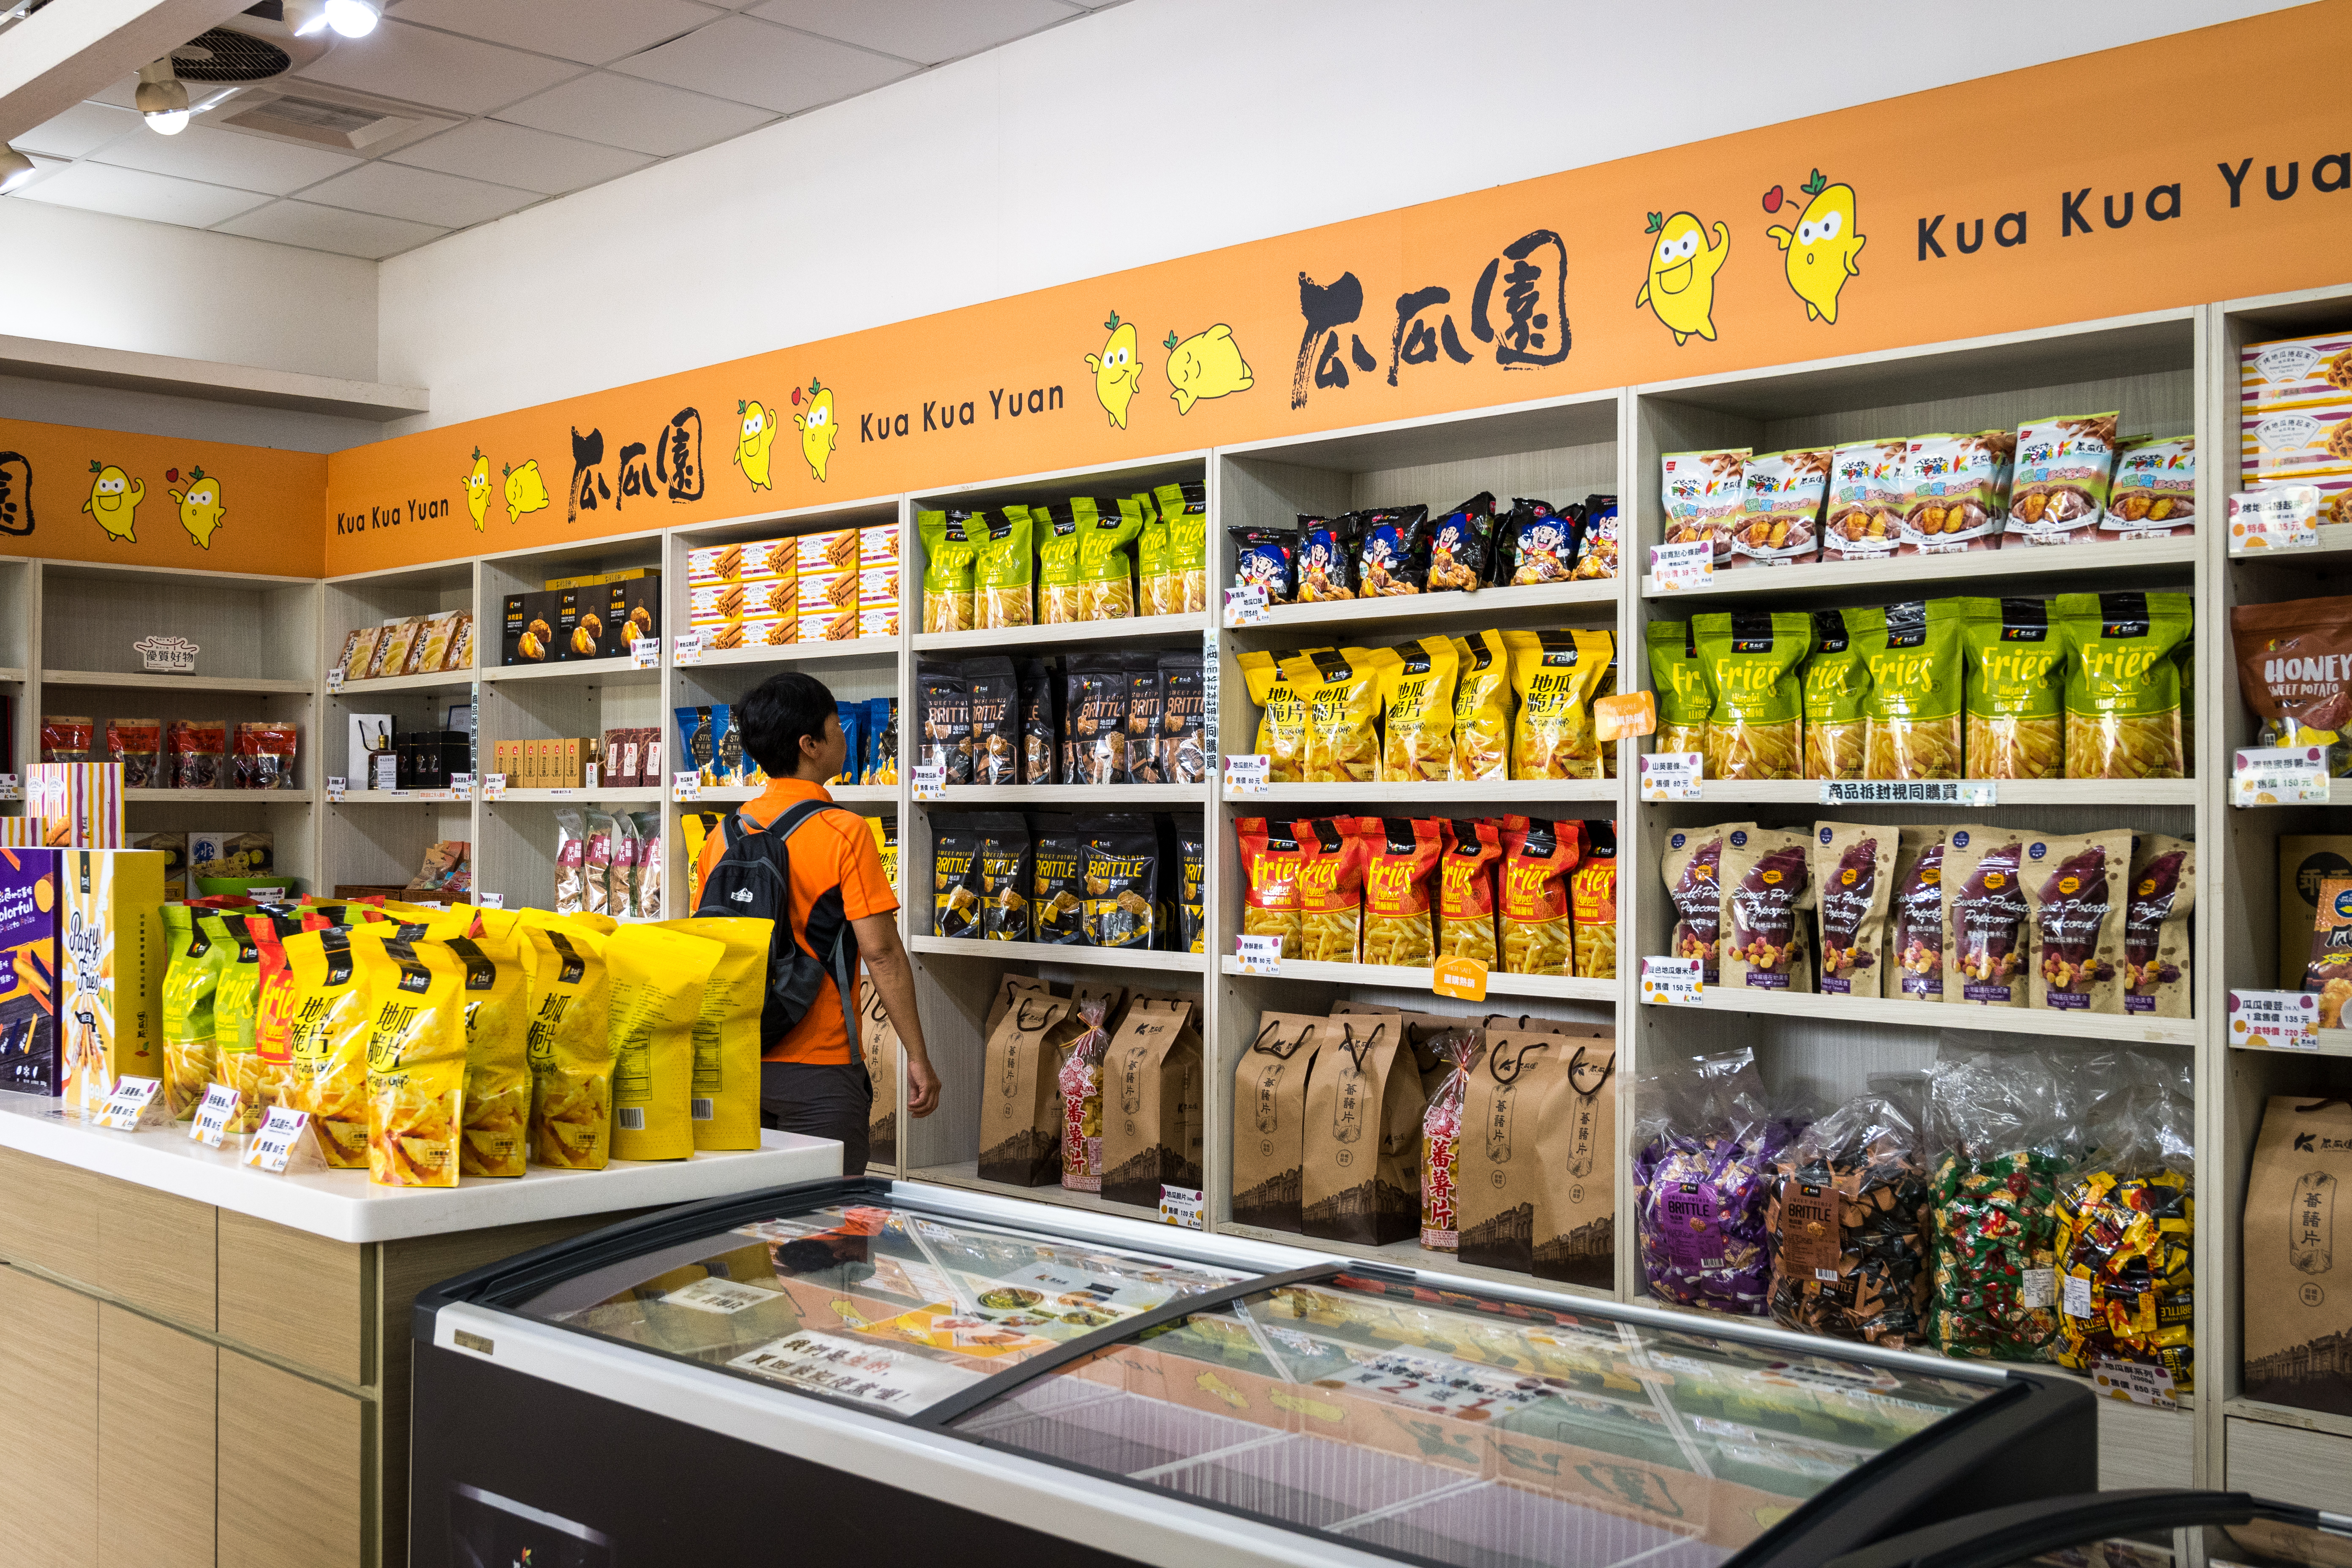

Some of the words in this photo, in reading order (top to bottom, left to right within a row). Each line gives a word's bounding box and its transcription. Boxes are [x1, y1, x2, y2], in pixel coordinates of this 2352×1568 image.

[1918, 211, 2027, 261] Kua
[2062, 182, 2180, 237] Kua
[2217, 151, 2352, 209] Yua
[2262, 349, 2311, 365] 烤地瓜捲起來
[861, 413, 909, 443] Kua
[923, 401, 975, 432] Kua
[989, 385, 1064, 420] Yuan
[2262, 418, 2311, 433] 烤地瓜捲起來
[1747, 480, 1781, 493] ドデカイ
[2241, 498, 2303, 514] 烤地瓜捲起來
[338, 513, 365, 535] Kua
[372, 506, 400, 529] Kua
[408, 498, 449, 521] Yuan
[2247, 523, 2267, 534] 特價
[2273, 523, 2289, 531] 135
[2291, 521, 2301, 531] 元
[1661, 548, 1701, 559] 超寬點心條餅
[1664, 570, 1678, 578] 特價
[146, 650, 193, 662] 優質好物
[1982, 647, 2053, 694] Fries
[2082, 643, 2156, 691] Fries
[2264, 653, 2352, 683] HONEY
[1530, 673, 1572, 692] 地瓜
[1716, 658, 1781, 702] Fries
[1397, 679, 1427, 700] 地瓜
[1731, 692, 1760, 703] Wasabi
[1883, 689, 1913, 699] Wasabi
[1998, 683, 2028, 696] Wasabi
[2269, 684, 2298, 697] SWEET
[2300, 683, 2339, 697] POTATO
[1082, 701, 1124, 718] BRITTL
[1206, 644, 1217, 770] 商品拆封視同購買
[1527, 693, 1568, 712] 脆片
[1805, 707, 1834, 718] 山葵薯條
[698, 733, 712, 741] STIC
[2258, 779, 2277, 788] 售價
[2284, 779, 2298, 787] 150
[2302, 777, 2311, 787] 元
[1828, 783, 1957, 800] 商品拆封視同購買
[568, 846, 575, 863] 芋片
[574, 841, 582, 858] 香酥
[594, 842, 602, 859] 芋片
[603, 839, 610, 856] 香酥
[618, 846, 626, 862] 芋片
[625, 840, 632, 857] 香酥
[936, 857, 970, 873] BRITTLE
[1036, 860, 1076, 877] BRITTLE
[1089, 860, 1142, 877] BRITTLE
[1184, 863, 1204, 878] BRIT
[1367, 857, 1415, 895] Fries
[1307, 884, 1325, 897] Pepper
[1377, 889, 1399, 899] Pepper
[1513, 893, 1533, 904] Pepper
[1732, 887, 1766, 901] Sweet
[1304, 898, 1325, 907] 香酥薯條
[1375, 901, 1400, 911] 香酥薯條
[1746, 901, 1791, 916] Popcorn
[1952, 894, 1984, 908] Sweet
[2065, 899, 2111, 913] Potato
[0, 898, 33, 922] olorful
[1510, 906, 1534, 916] 香酥薯條
[1825, 905, 1857, 920] Popcorn
[70, 911, 101, 958] Party
[77, 958, 100, 996] Fries
[1459, 966, 1472, 975] SALE
[1649, 966, 1695, 975] 雙色地瓜爆米花
[1444, 975, 1475, 988] 團購熱銷
[1655, 983, 1669, 991] 售價
[298, 995, 340, 1024] 地瓜
[538, 993, 571, 1023] 地瓜
[377, 1001, 417, 1037] 地瓜
[2253, 1013, 2280, 1022] 盒售價
[2284, 1015, 2298, 1023] 135
[2300, 1015, 2310, 1024] 元
[265, 1020, 285, 1036] Pepper
[2253, 1026, 2280, 1036] 盒特價
[2300, 1029, 2310, 1037] 元
[292, 1023, 334, 1054] 脆片
[529, 1021, 556, 1054] 脆片
[368, 1031, 406, 1068] 脆片
[388, 1074, 410, 1089] Chips
[269, 1117, 291, 1130] 地瓜脆片
[1064, 1098, 1087, 1175] 蕃薯片
[1428, 1140, 1455, 1229] 蕃薯片
[1166, 1190, 1186, 1200] 地瓜脆片
[1168, 1207, 1178, 1215] 售價
[1668, 1200, 1710, 1217] BRITTLE
[1788, 1203, 1832, 1222] BRITTLE
[2104, 1362, 2153, 1378] 地瓜酥系列
[2134, 1385, 2148, 1393] 650
[2151, 1388, 2161, 1396] 元
